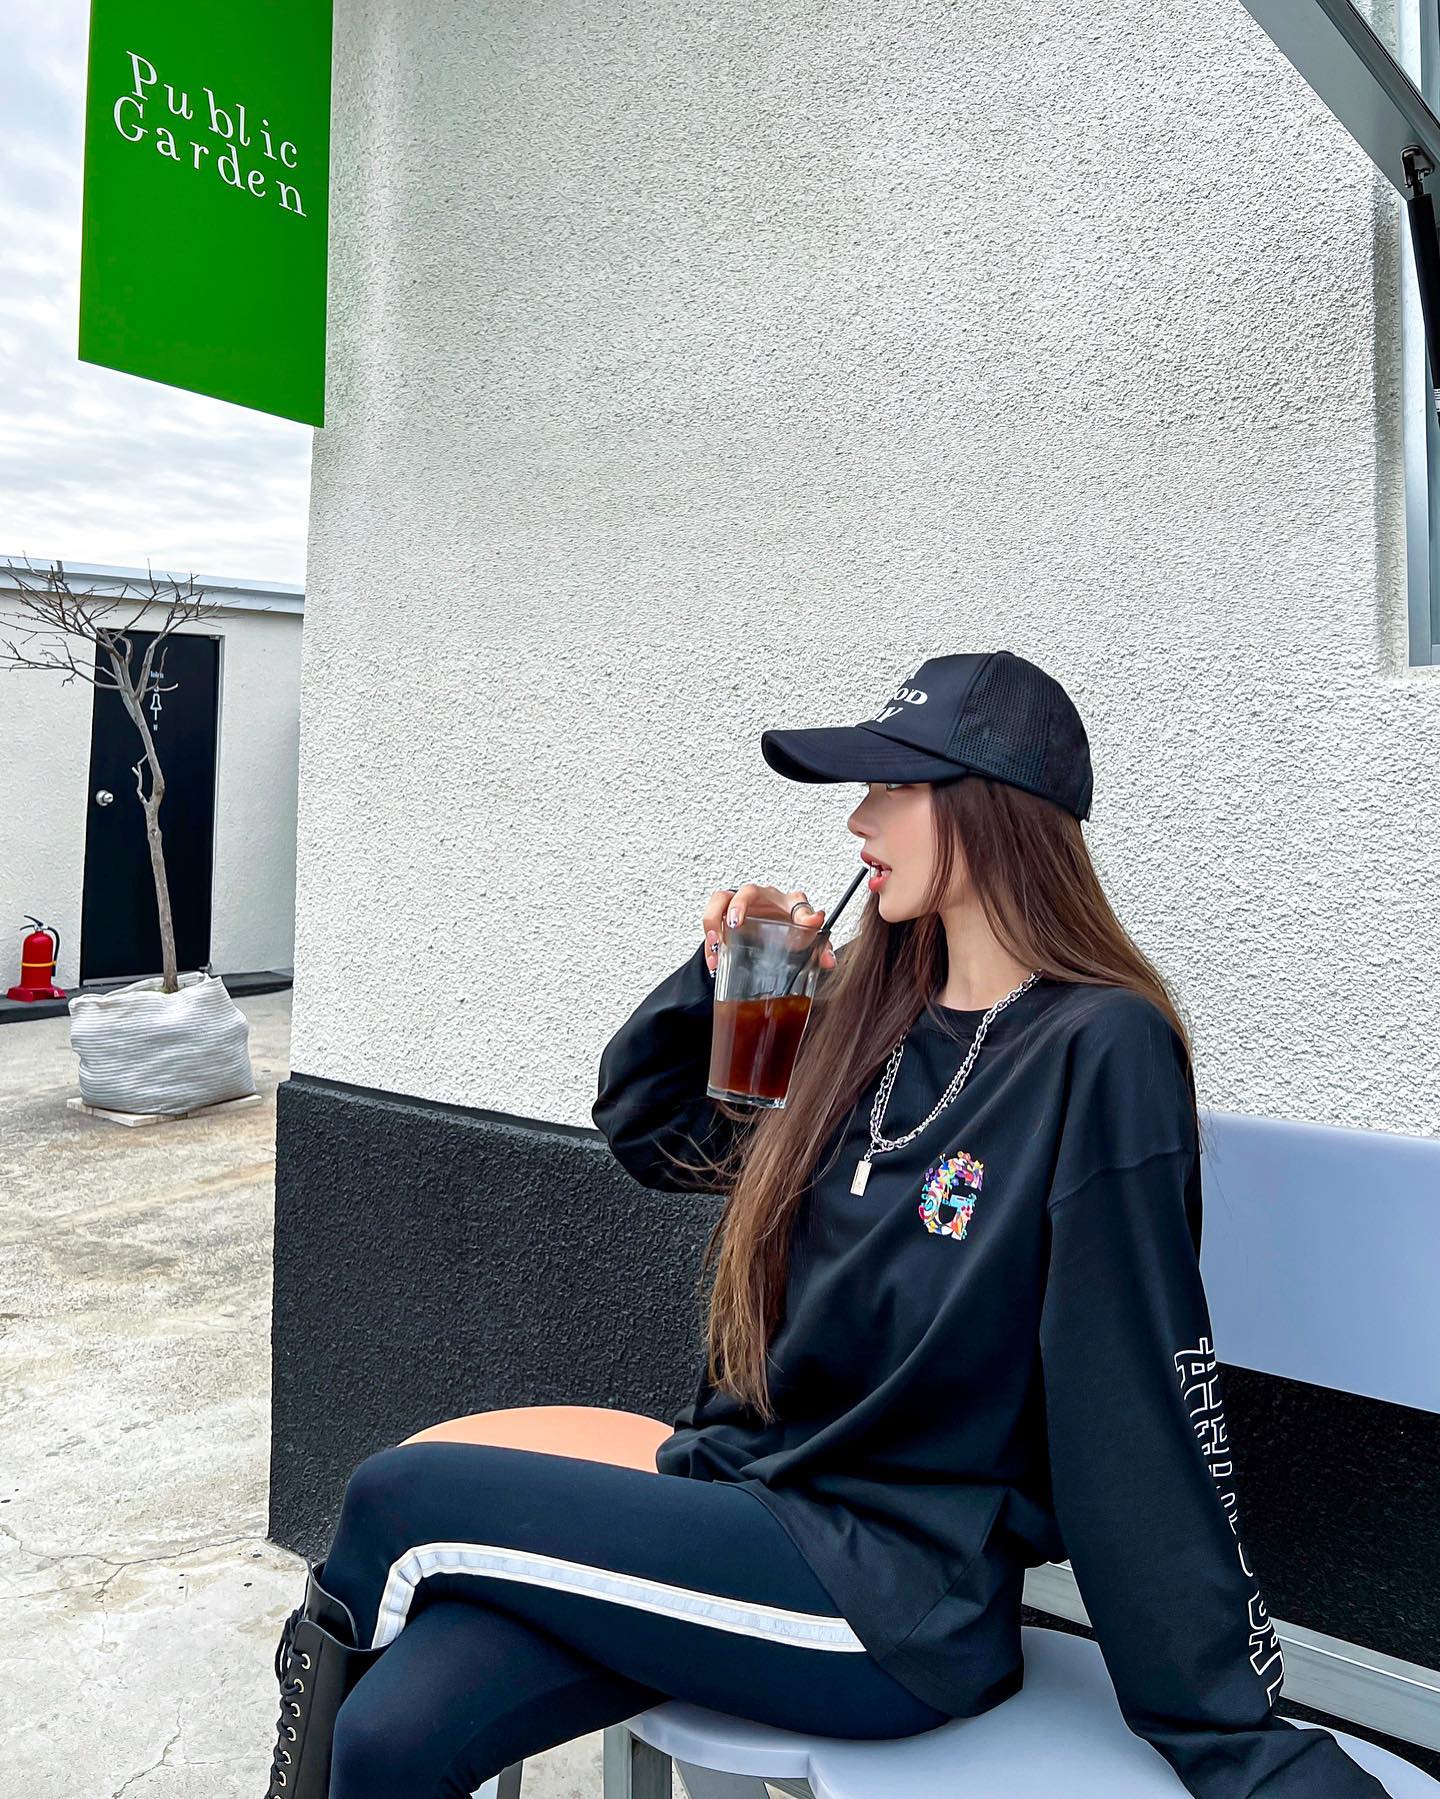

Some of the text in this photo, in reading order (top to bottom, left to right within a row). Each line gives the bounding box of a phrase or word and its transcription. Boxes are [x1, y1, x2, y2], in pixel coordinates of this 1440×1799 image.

[113, 96, 307, 217] Garden
[126, 50, 297, 168] Public
[893, 687, 928, 705] OD
